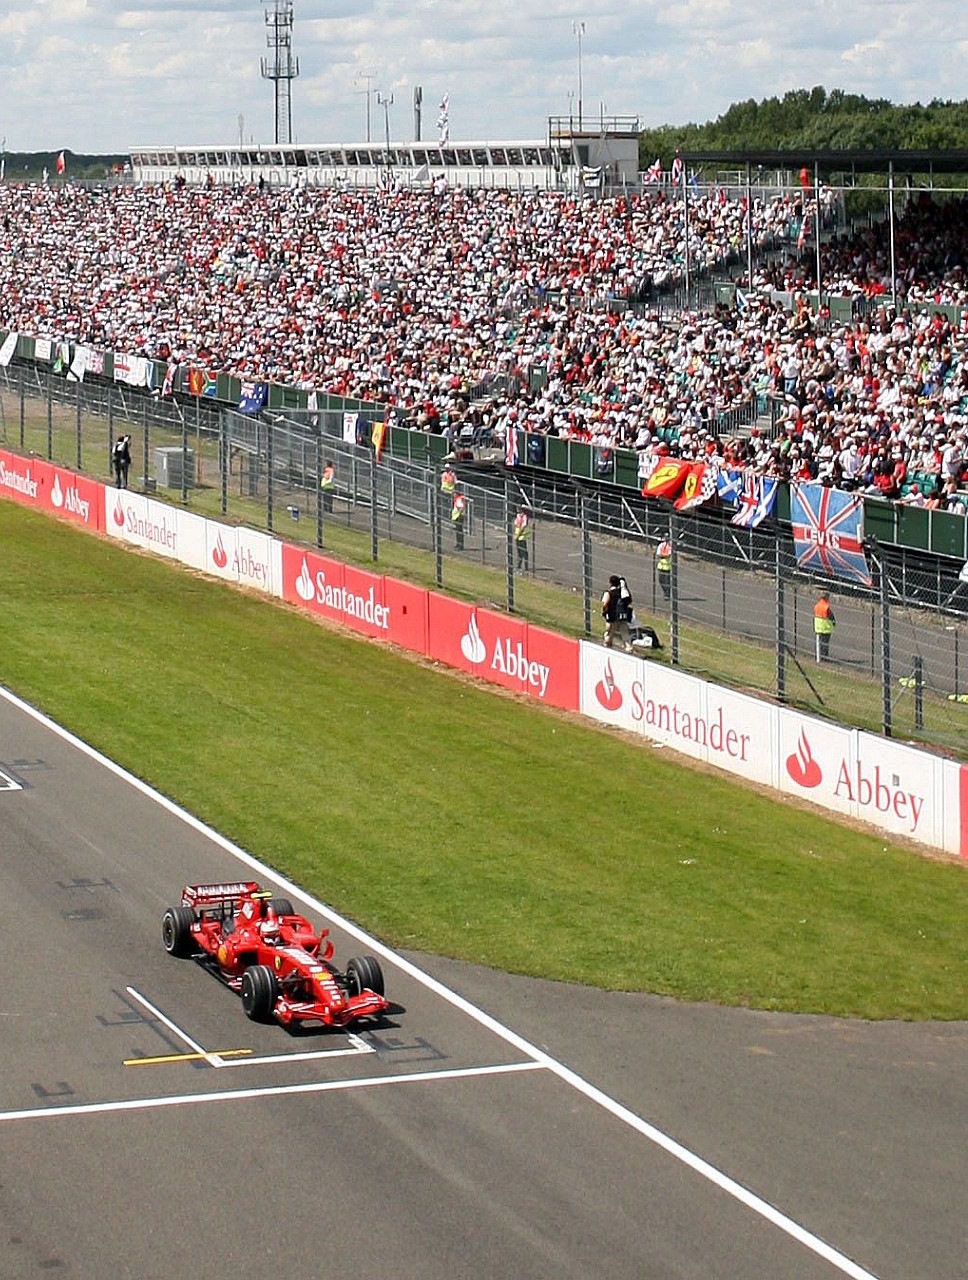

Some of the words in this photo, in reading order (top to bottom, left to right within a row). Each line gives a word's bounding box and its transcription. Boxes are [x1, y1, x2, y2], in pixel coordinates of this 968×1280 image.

[0, 460, 38, 498] Santander
[65, 487, 90, 522] Abbey
[126, 506, 178, 551] Santander
[231, 547, 270, 587] Abbey
[316, 571, 390, 629] Santander
[491, 636, 550, 698] Abbey
[631, 681, 751, 762] Santander
[833, 757, 925, 833] Abbey
